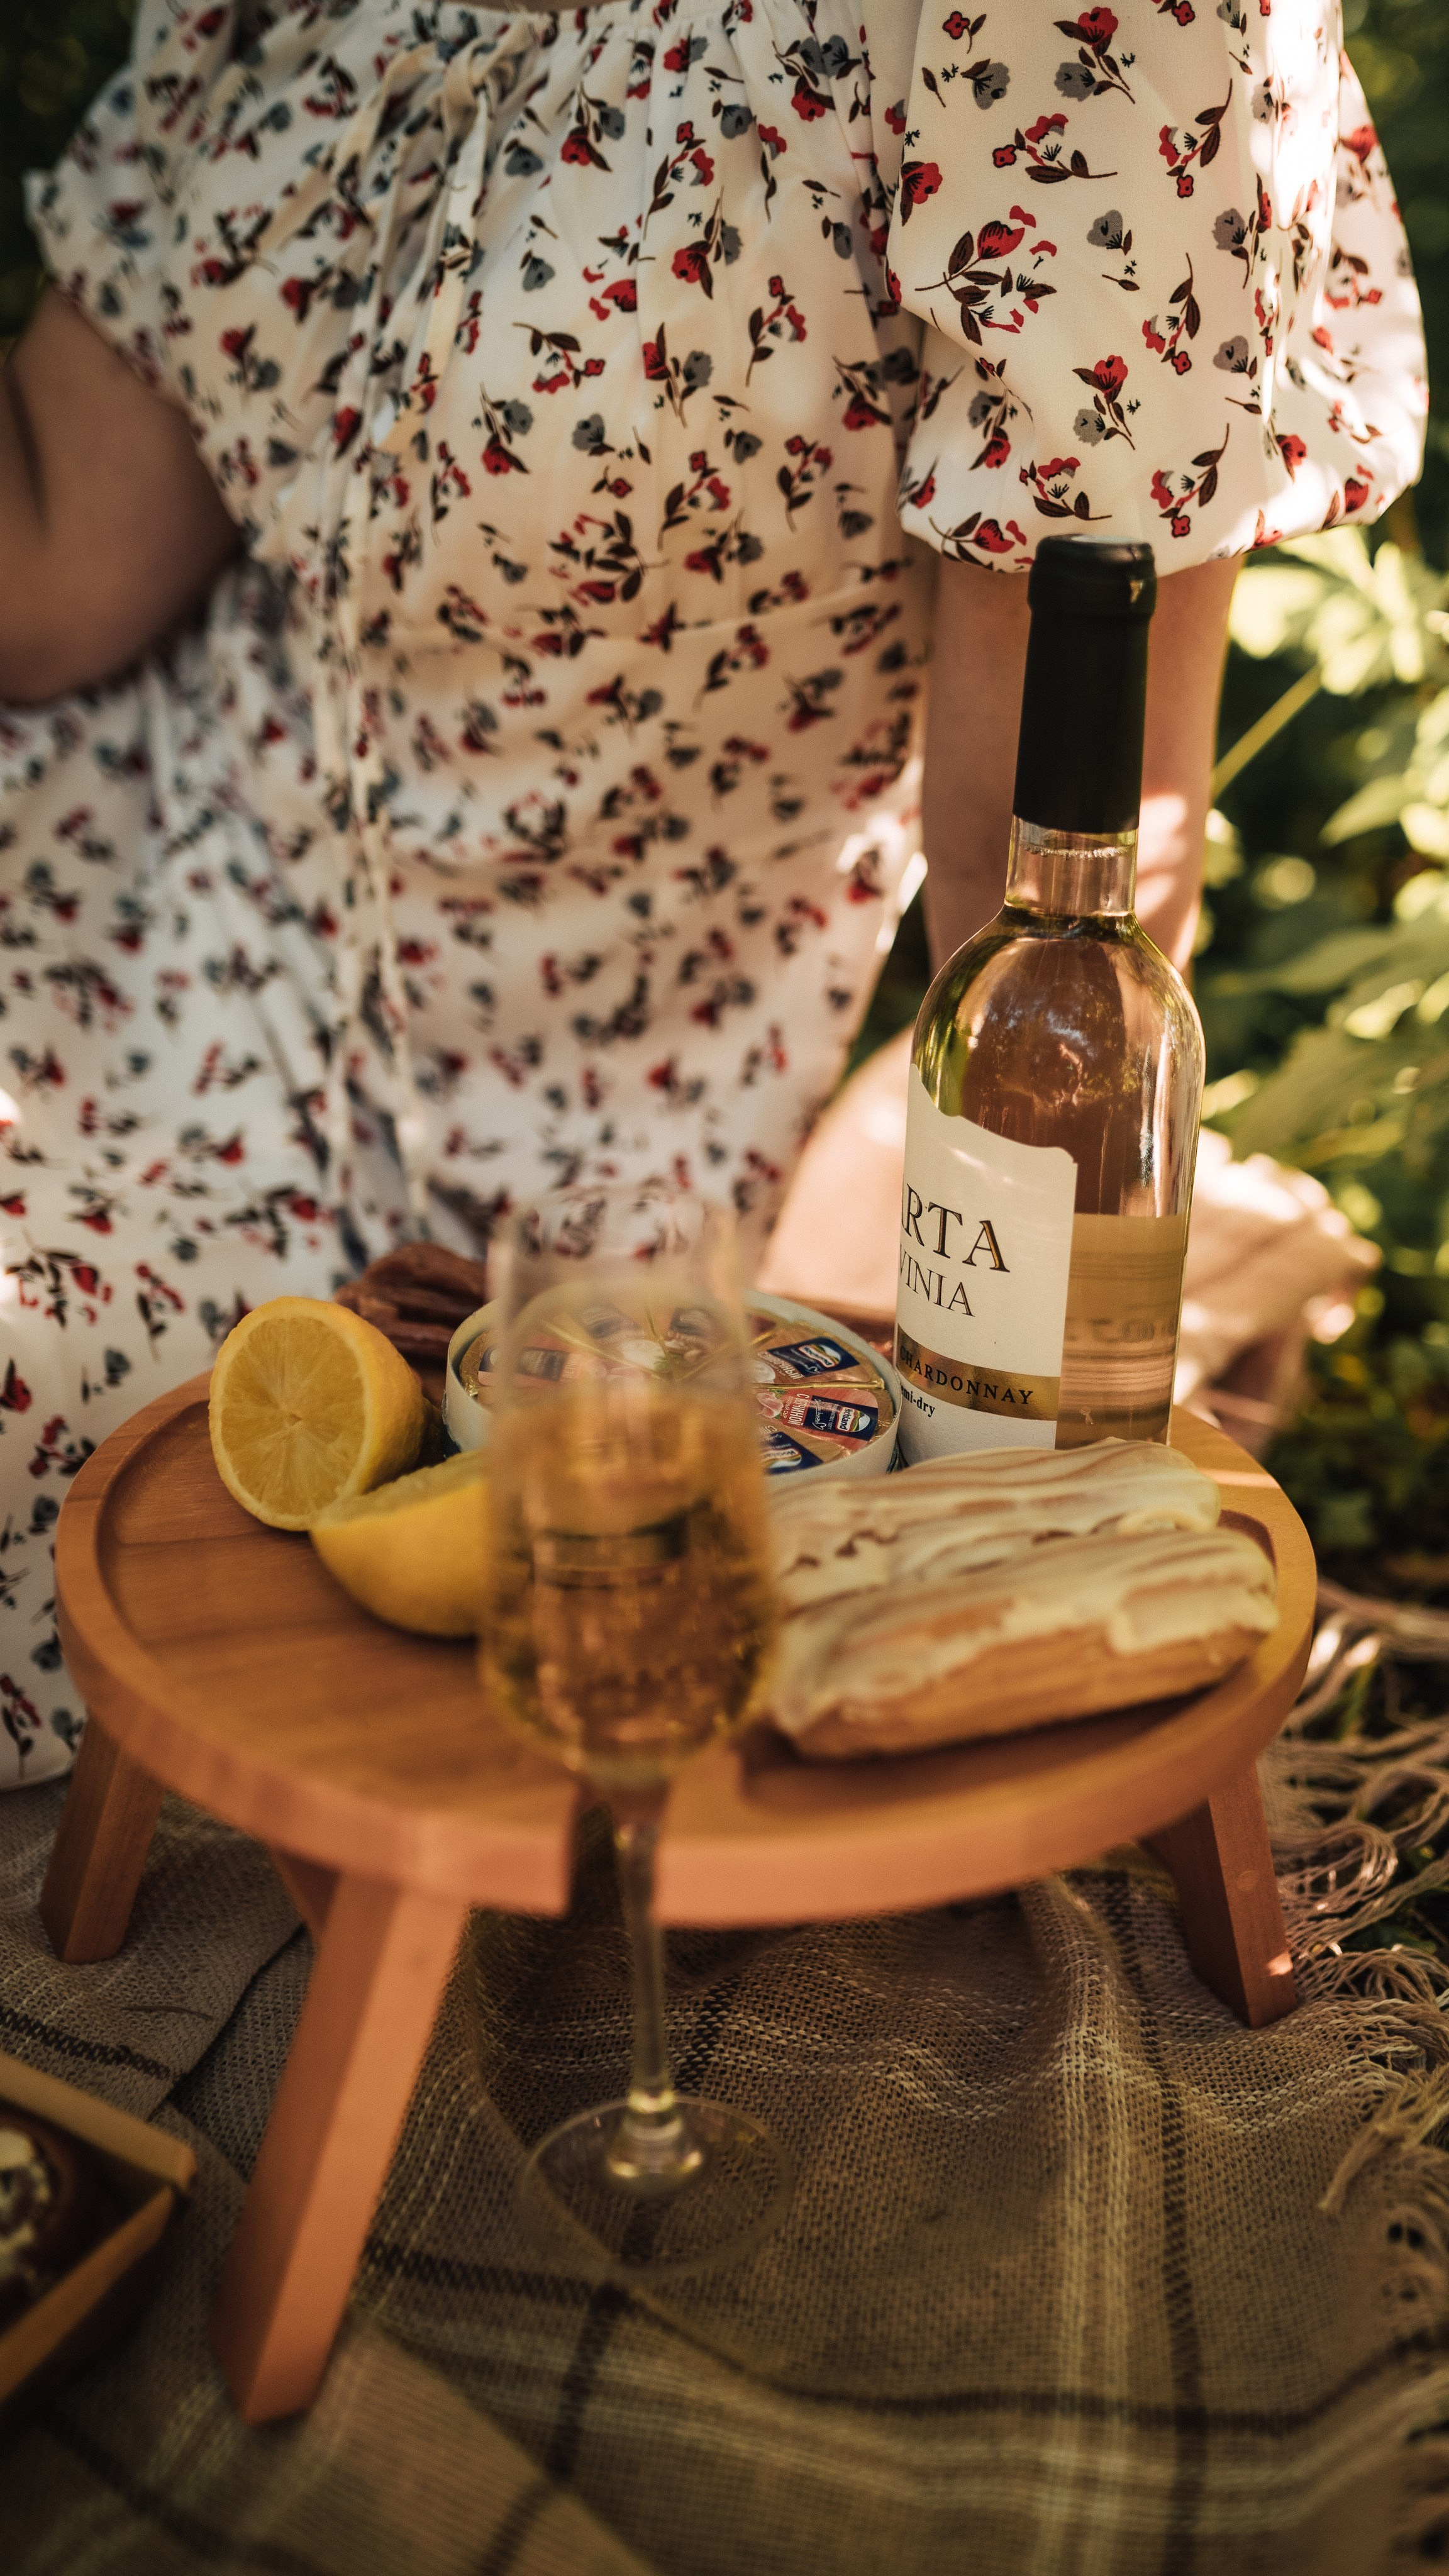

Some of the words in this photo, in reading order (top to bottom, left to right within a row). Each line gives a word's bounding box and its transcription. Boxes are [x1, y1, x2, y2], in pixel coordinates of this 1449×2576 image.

[902, 1183, 1010, 1273] RTA
[900, 1345, 1033, 1405] CHARDONNAY
[901, 1385, 936, 1418] emi-dry
